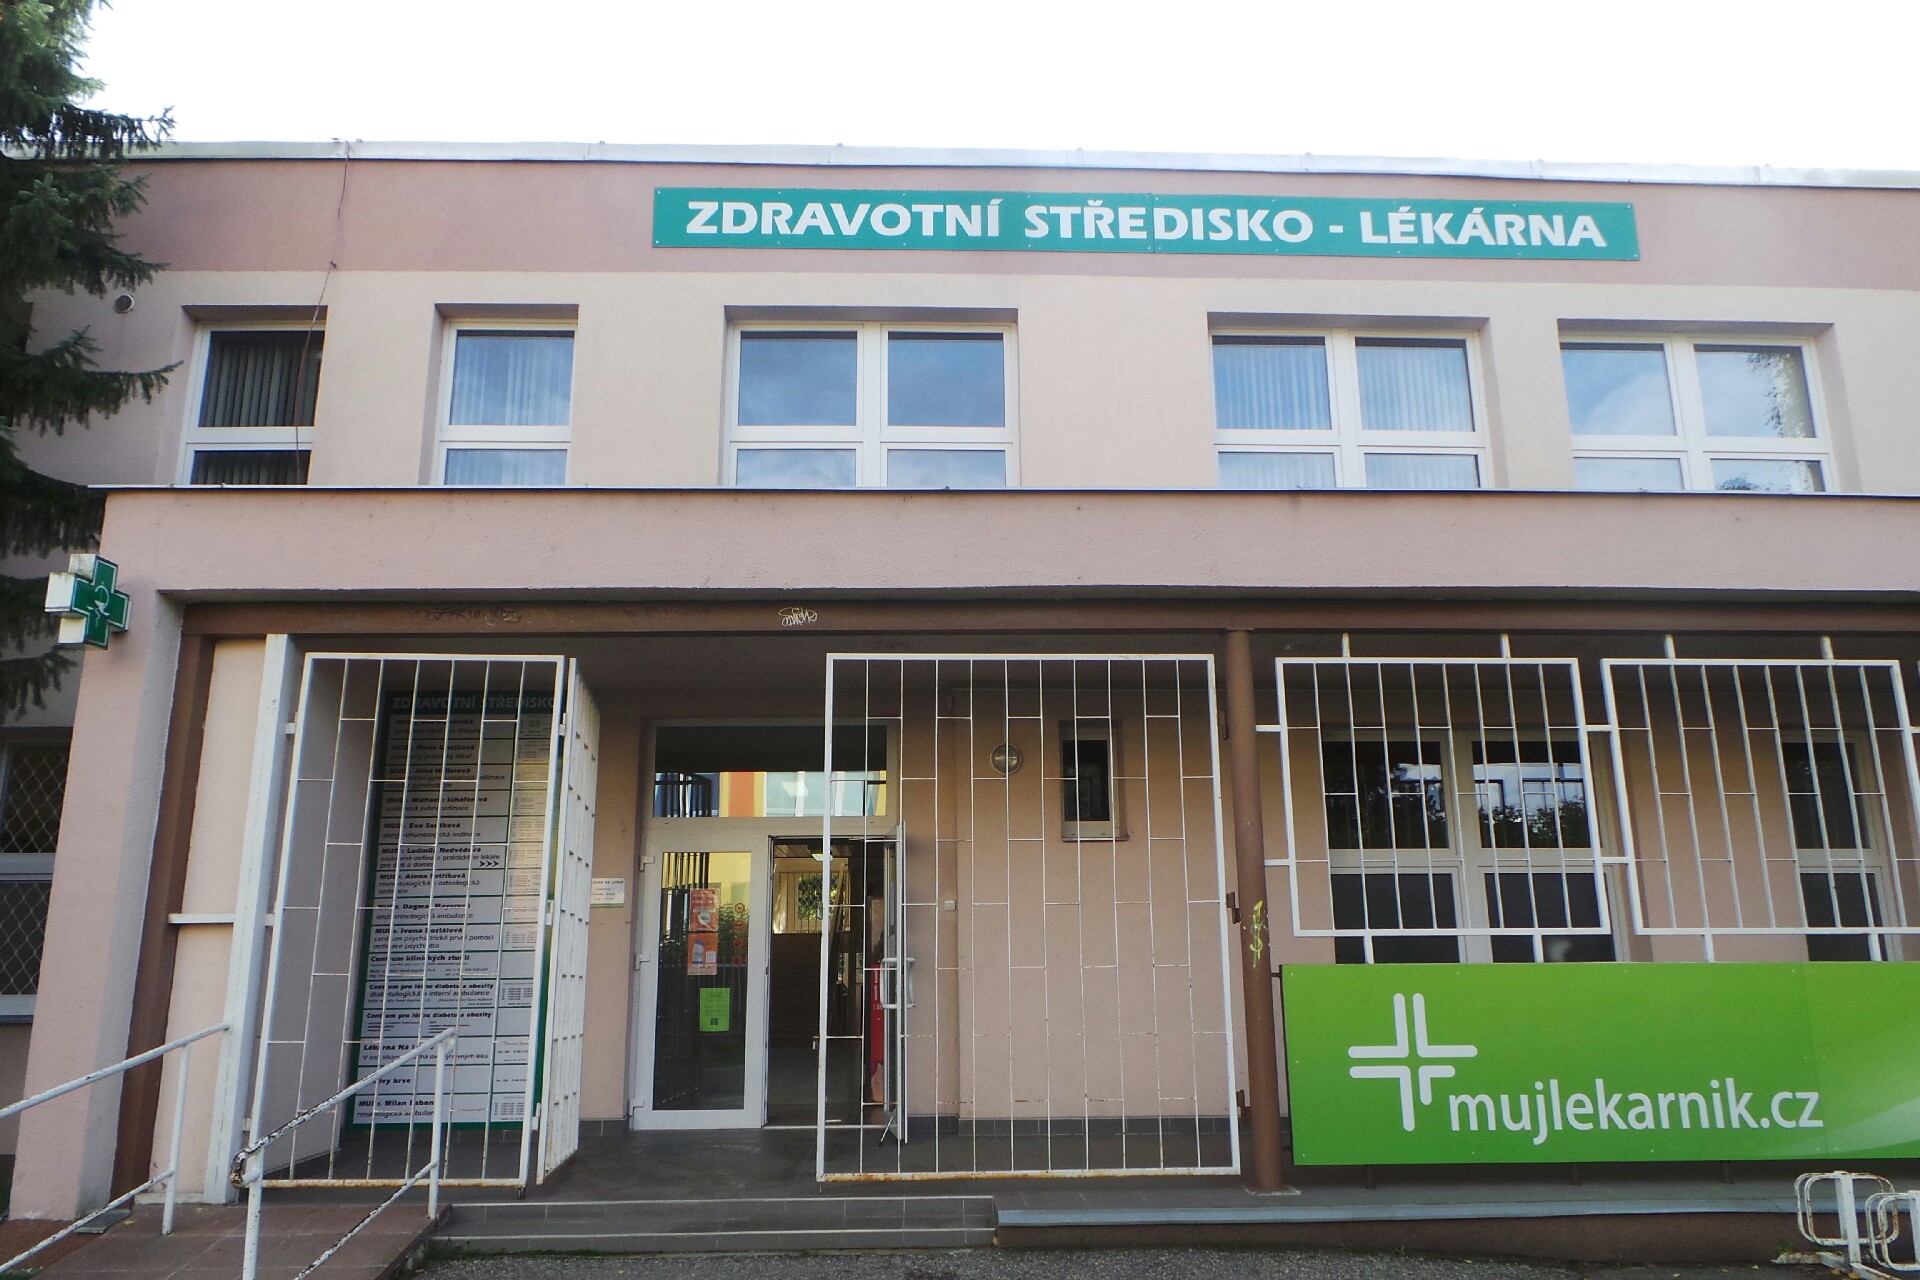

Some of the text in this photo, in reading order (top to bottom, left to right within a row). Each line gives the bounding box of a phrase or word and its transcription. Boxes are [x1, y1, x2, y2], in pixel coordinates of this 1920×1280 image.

[687, 199, 1607, 247] ZDRAVOTNÍ STŘEDISKO - LÉKÁRNA
[468, 982, 494, 990] obezity
[466, 1011, 493, 1019] obezity
[1449, 1078, 1824, 1145] mujlekarnik.cz
